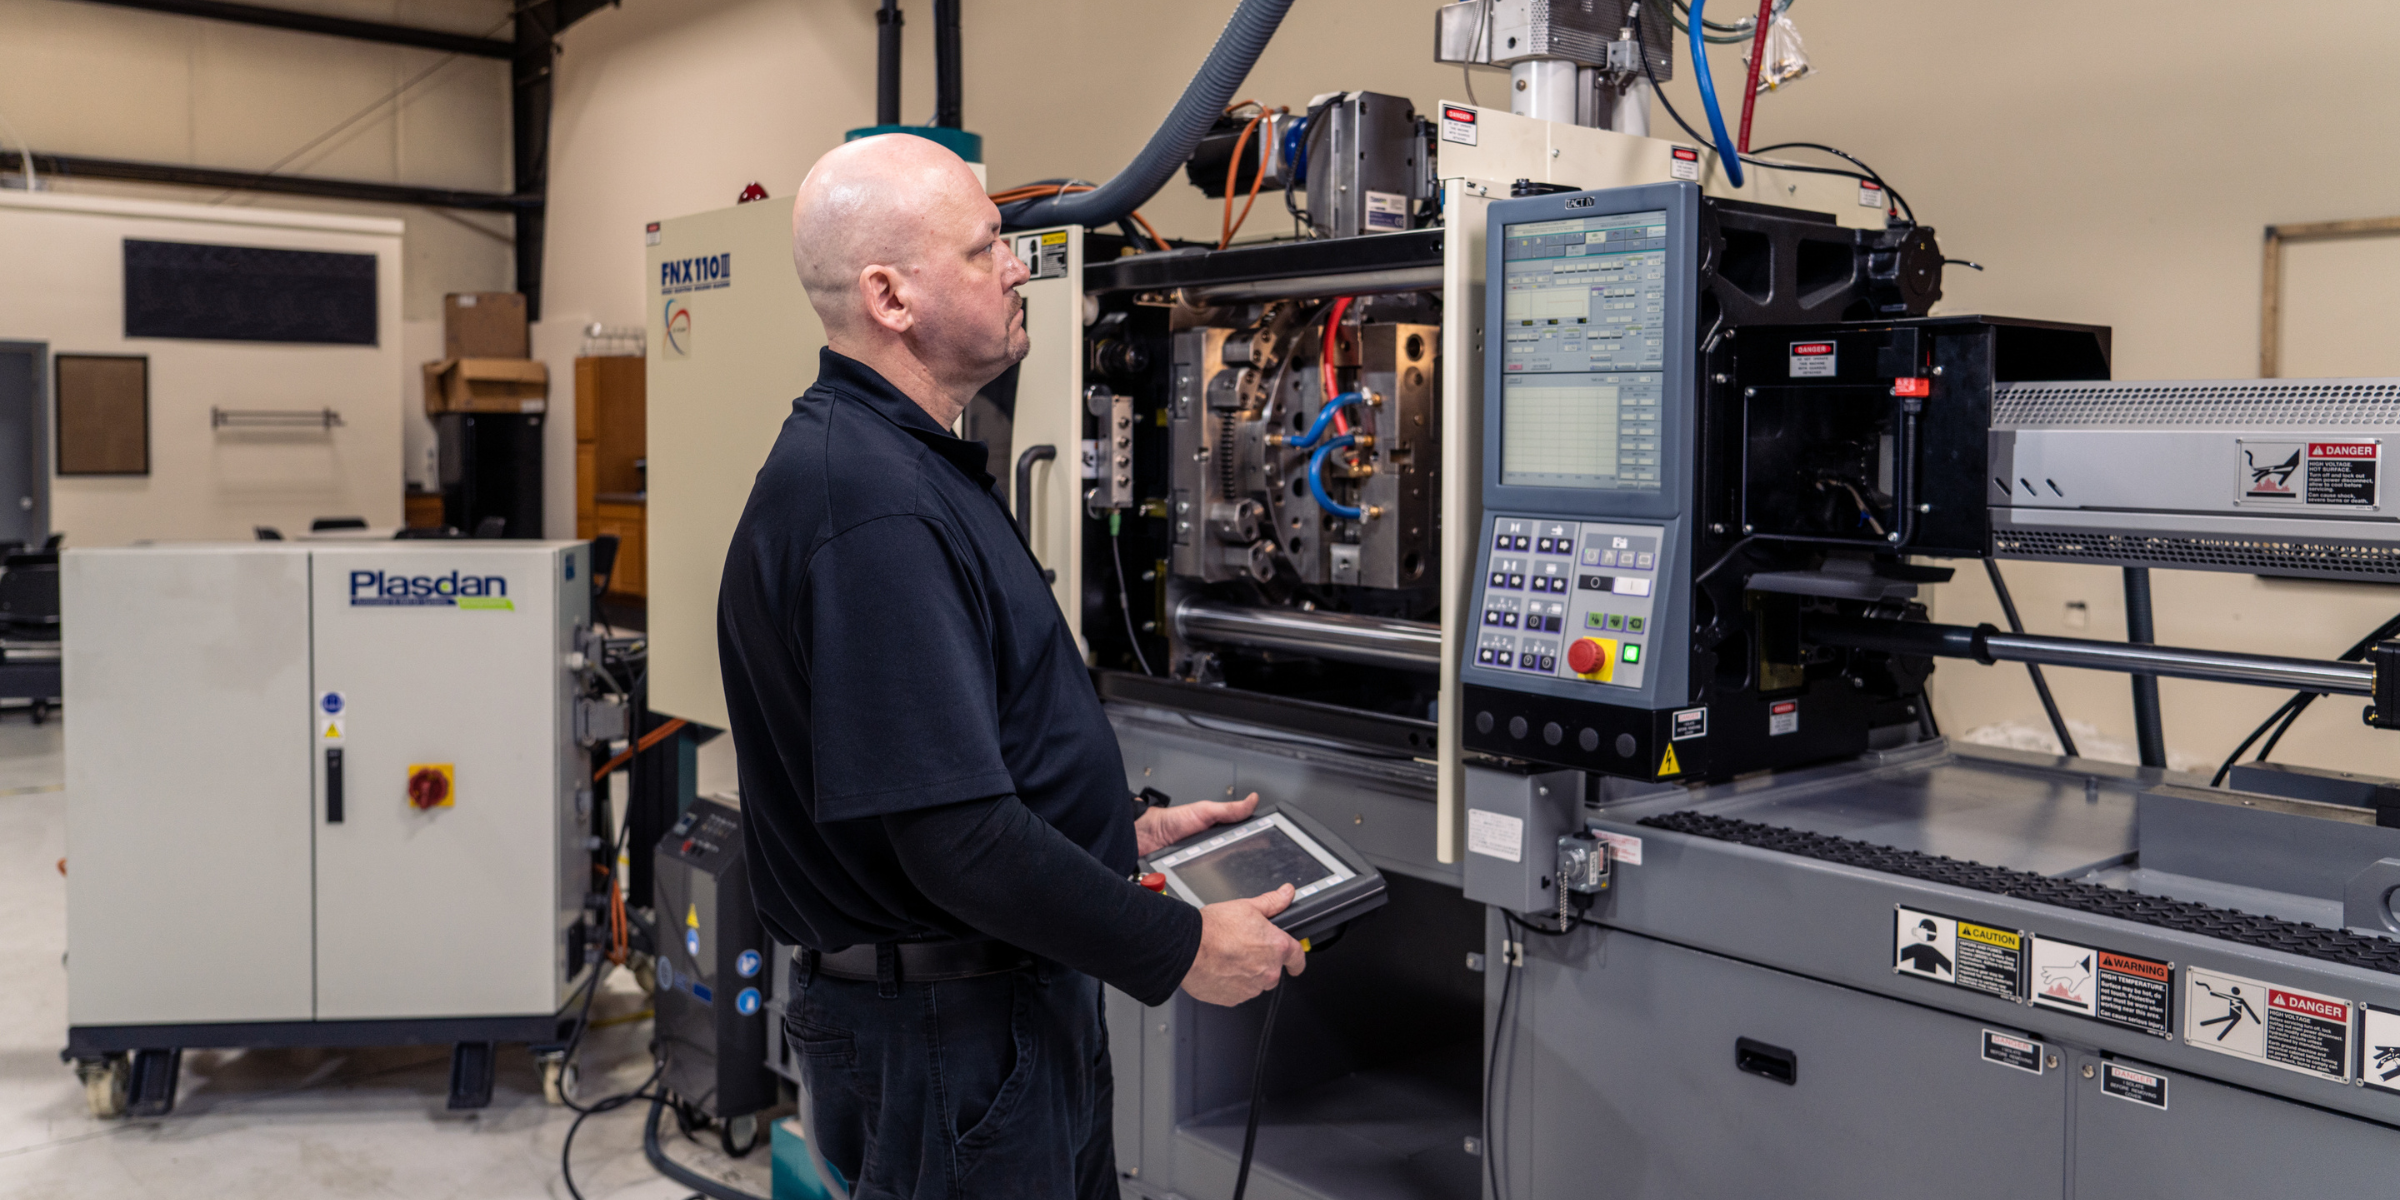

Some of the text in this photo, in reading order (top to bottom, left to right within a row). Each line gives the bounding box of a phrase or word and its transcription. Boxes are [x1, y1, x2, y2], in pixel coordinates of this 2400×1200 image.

[1449, 110, 1470, 120] DANGER
[1567, 198, 1585, 208] TACT
[2326, 447, 2372, 455] DANGER
[349, 570, 507, 597] Plasdan
[1973, 929, 2015, 945] CAUTION
[2114, 958, 2164, 977] WARNING
[2101, 973, 2165, 992] HIGH TEMPERATURE.
[2101, 981, 2121, 990] Surface
[2128, 994, 2155, 1005] Protective
[2101, 1001, 2121, 1012] working
[2290, 997, 2341, 1018] DANGER
[2101, 1009, 2164, 1030] Can cause serious injury.
[2284, 1020, 2303, 1028] servicing
[2285, 1013, 2311, 1023] VOLTAGE
[1994, 1035, 2030, 1050] DANGER
[2114, 1068, 2152, 1085] DANGER
